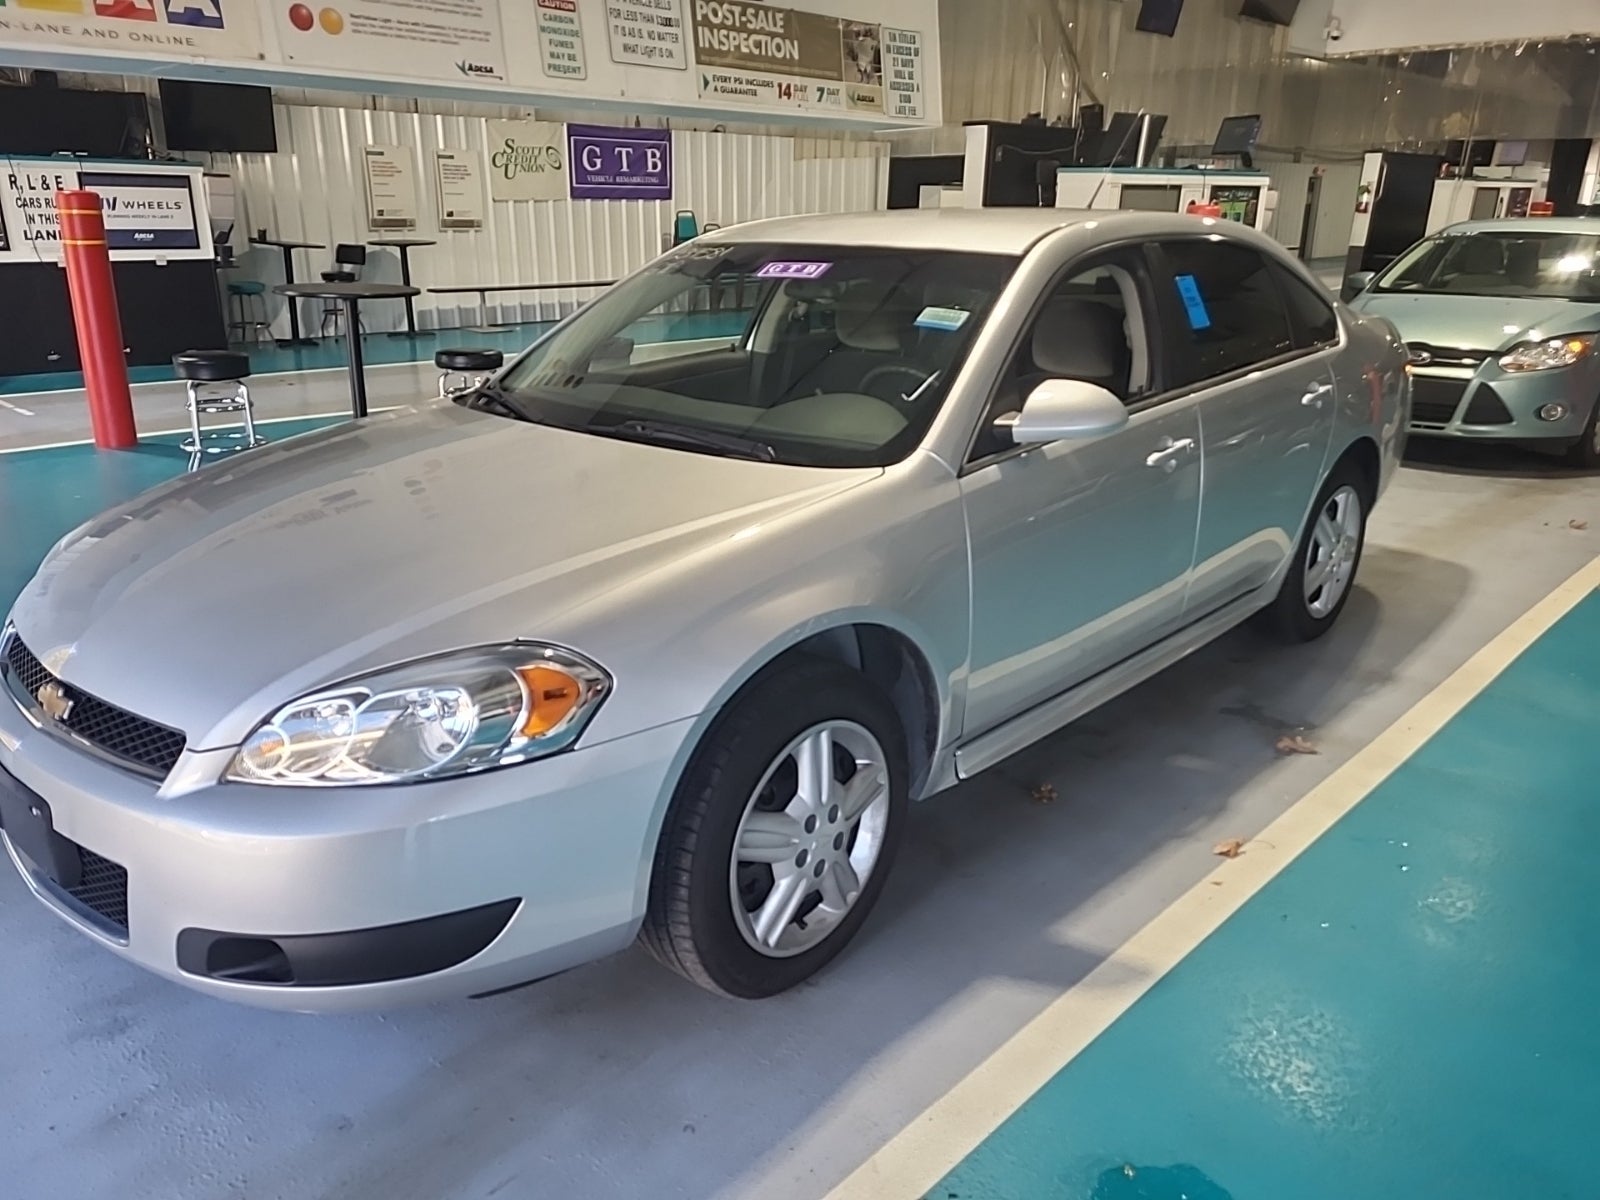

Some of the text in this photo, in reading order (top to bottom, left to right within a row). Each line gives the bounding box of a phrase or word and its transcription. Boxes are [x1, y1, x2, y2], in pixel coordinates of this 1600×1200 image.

[543, 13, 574, 25] CARBON
[609, 7, 621, 19] FOR
[623, 10, 638, 22] LESS
[639, 12, 655, 24] THAN
[695, 0, 784, 33] POST-SALE
[81, 27, 120, 40] AND
[128, 31, 195, 46] ONLINE
[540, 25, 581, 38] MONOXIDE
[657, 31, 679, 43] MATTER
[548, 38, 574, 49] FUMES
[697, 26, 799, 60] INSPECTION
[549, 51, 577, 62] MAY BE
[547, 63, 581, 74] PRESENT
[712, 74, 732, 84] EVERY
[745, 78, 774, 88] INCLUDES
[713, 85, 758, 96] A GUARANTEE
[777, 82, 840, 102] 14 DAY 7 DAY
[26, 174, 36, 190] L
[41, 174, 51, 190] &
[54, 175, 64, 191] E
[15, 197, 58, 208] CARS RU
[122, 200, 183, 210] WHEELS
